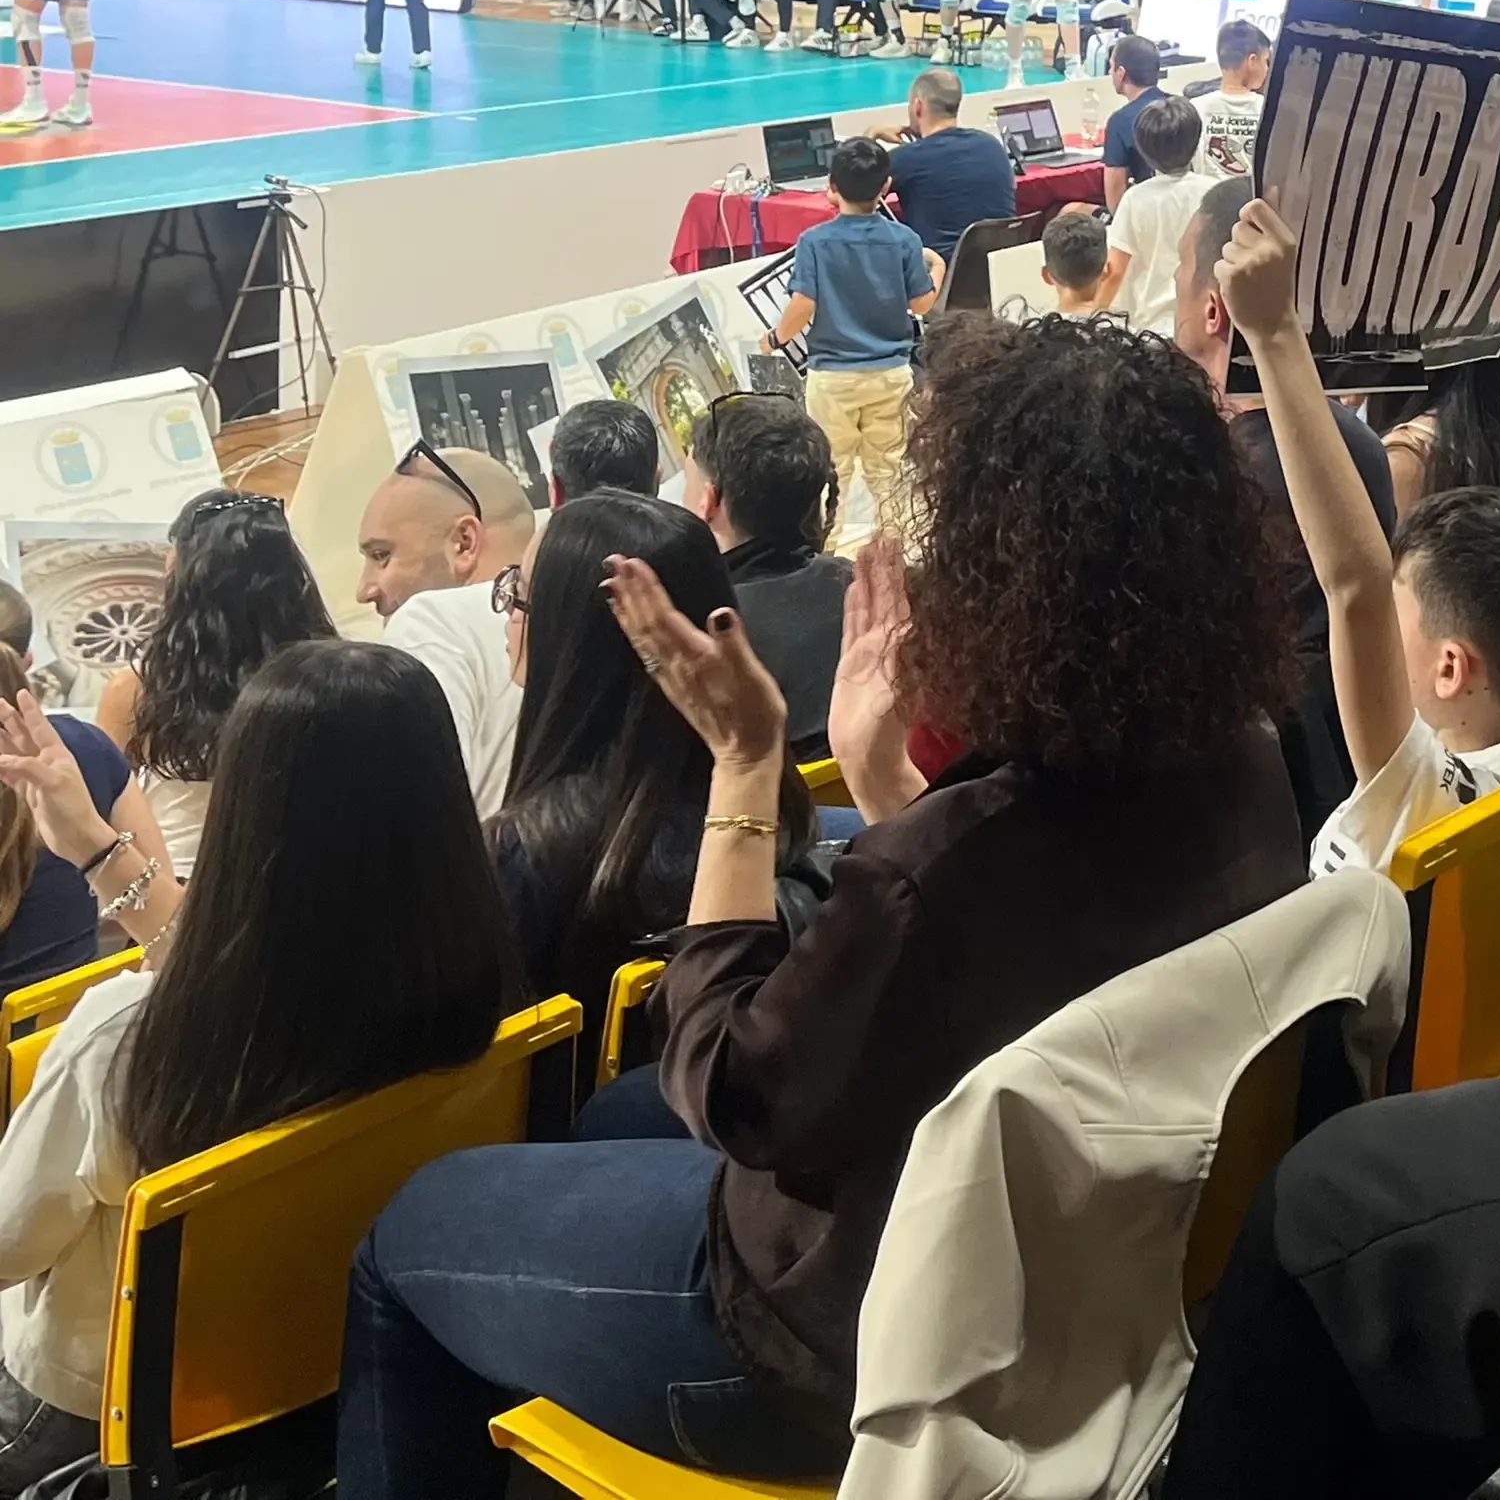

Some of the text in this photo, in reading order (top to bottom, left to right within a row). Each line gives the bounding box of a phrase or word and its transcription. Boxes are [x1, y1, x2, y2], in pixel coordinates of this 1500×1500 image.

[1210, 115, 1257, 127] Air Jordan
[1206, 126, 1256, 136] Has Lande
